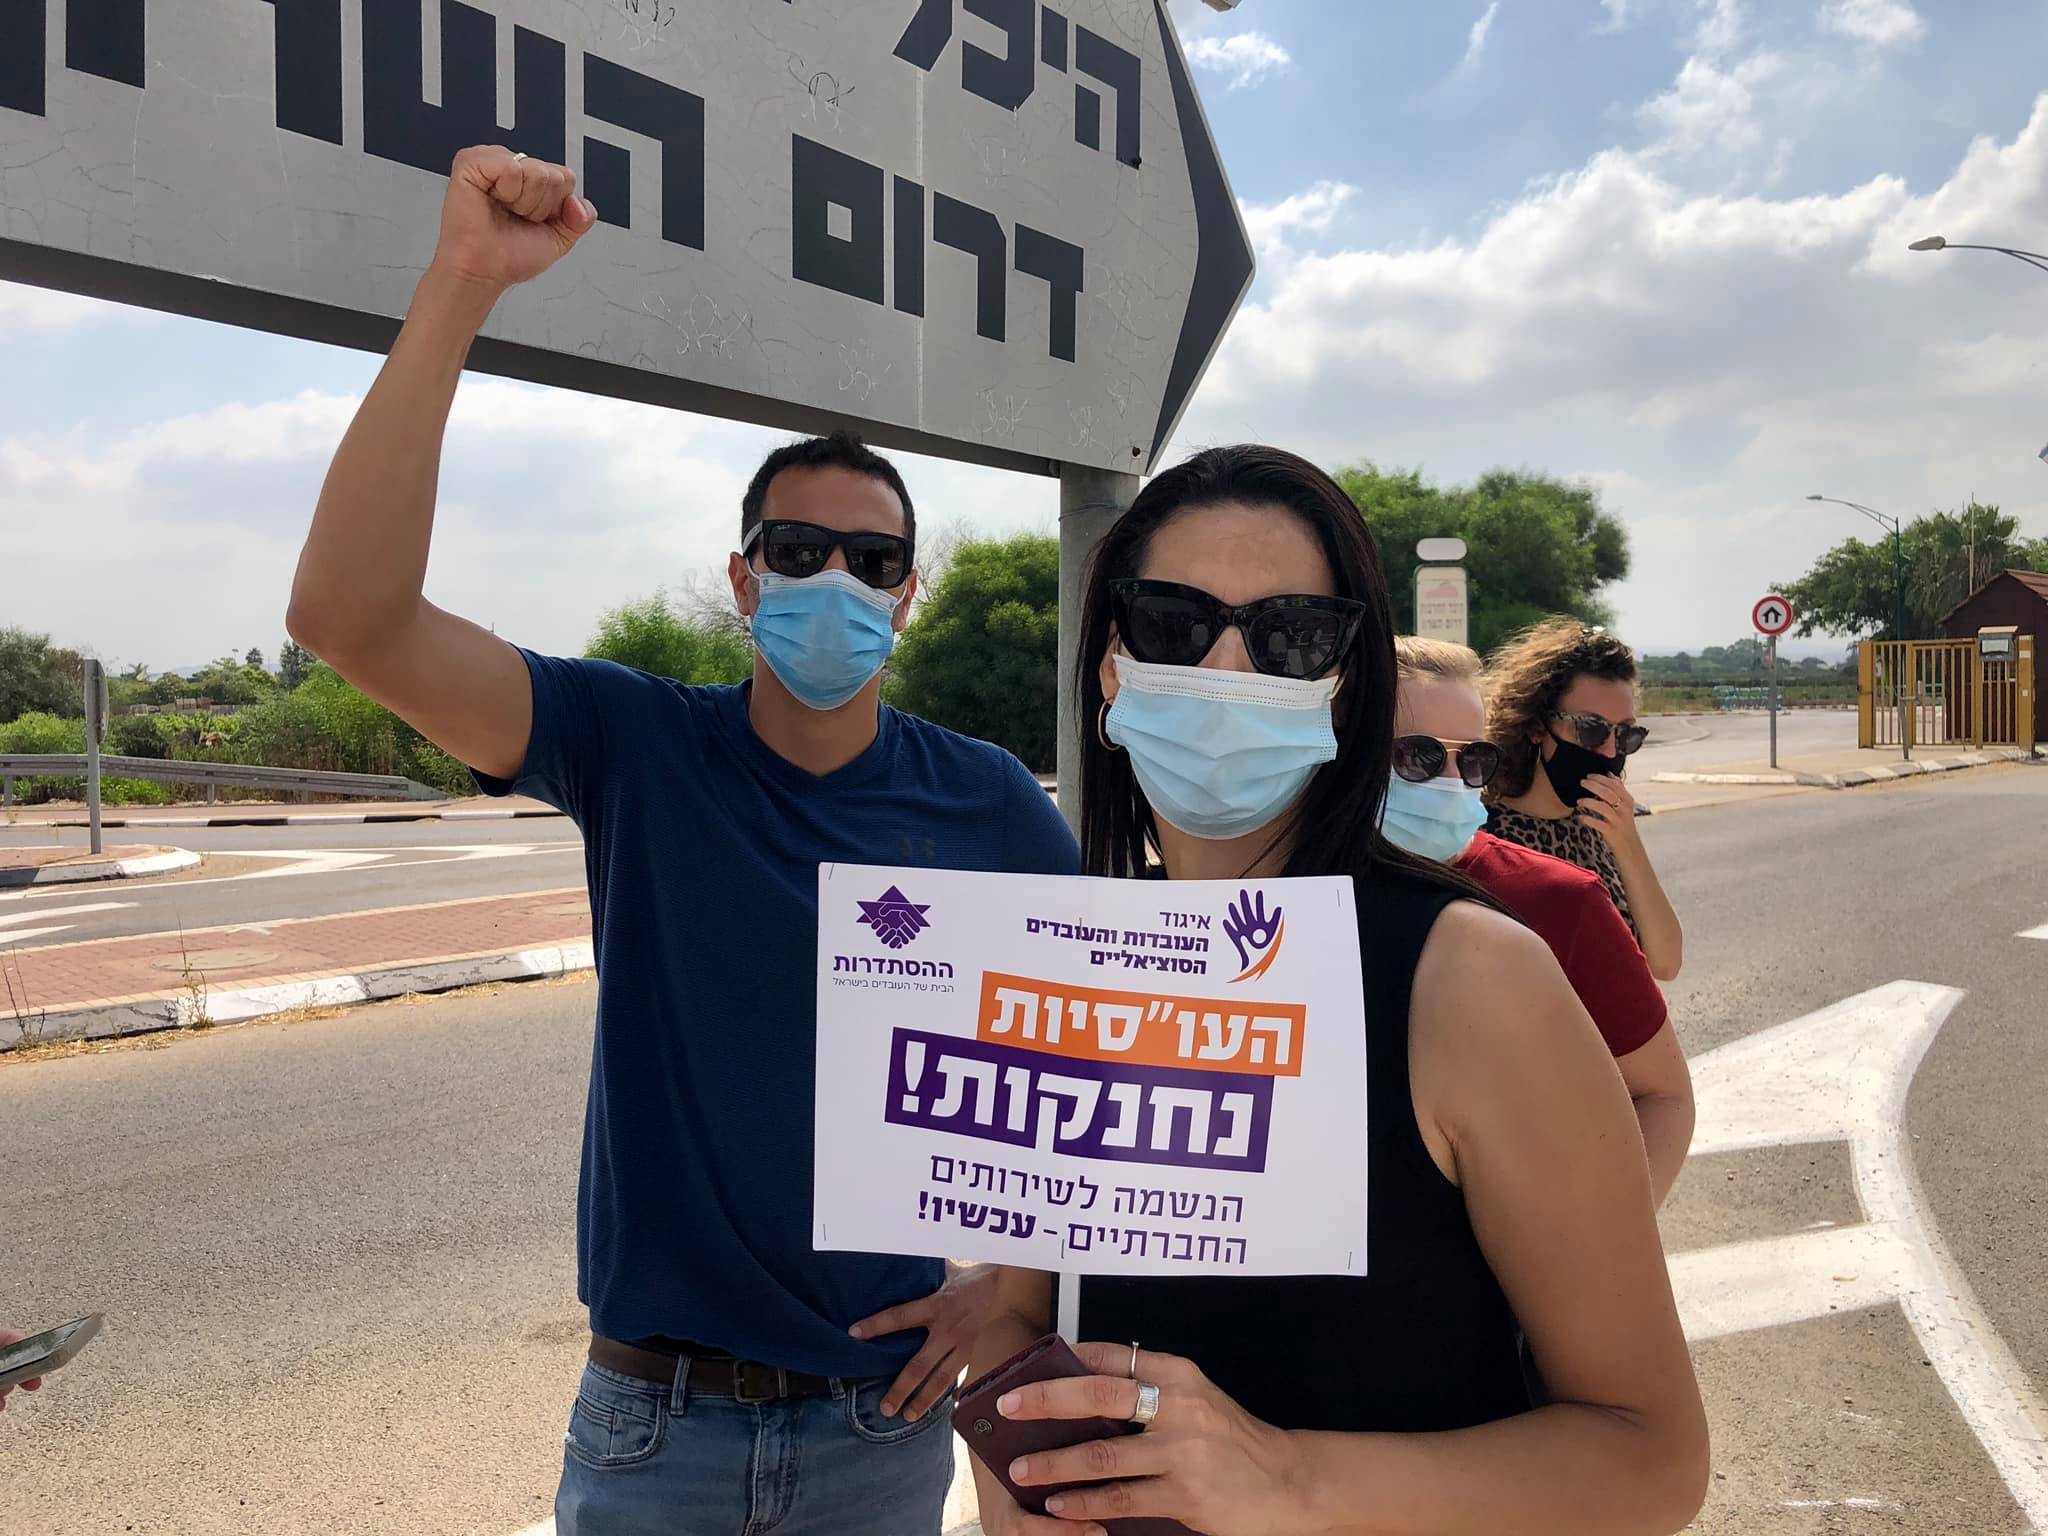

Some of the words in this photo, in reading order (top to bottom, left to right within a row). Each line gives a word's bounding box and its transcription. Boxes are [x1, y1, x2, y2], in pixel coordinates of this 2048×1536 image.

[792, 133, 1084, 363] דרום
[1026, 917, 1118, 944] והעובדים
[1159, 911, 1212, 930] איגוד
[1122, 930, 1209, 952] העובדות
[833, 955, 954, 979] ההסתדרות
[1090, 949, 1207, 975] הסוציאליים
[832, 976, 869, 988] בישראל
[871, 979, 911, 991] העובדים
[914, 982, 928, 992] של
[930, 983, 955, 993] הבית
[990, 987, 1292, 1065] העו"סיות
[901, 1040, 1255, 1158] נחנקות!
[930, 1155, 1099, 1210] לשירותים
[918, 1190, 1037, 1239] עכשיו!
[1114, 1186, 1244, 1223] הנשמה
